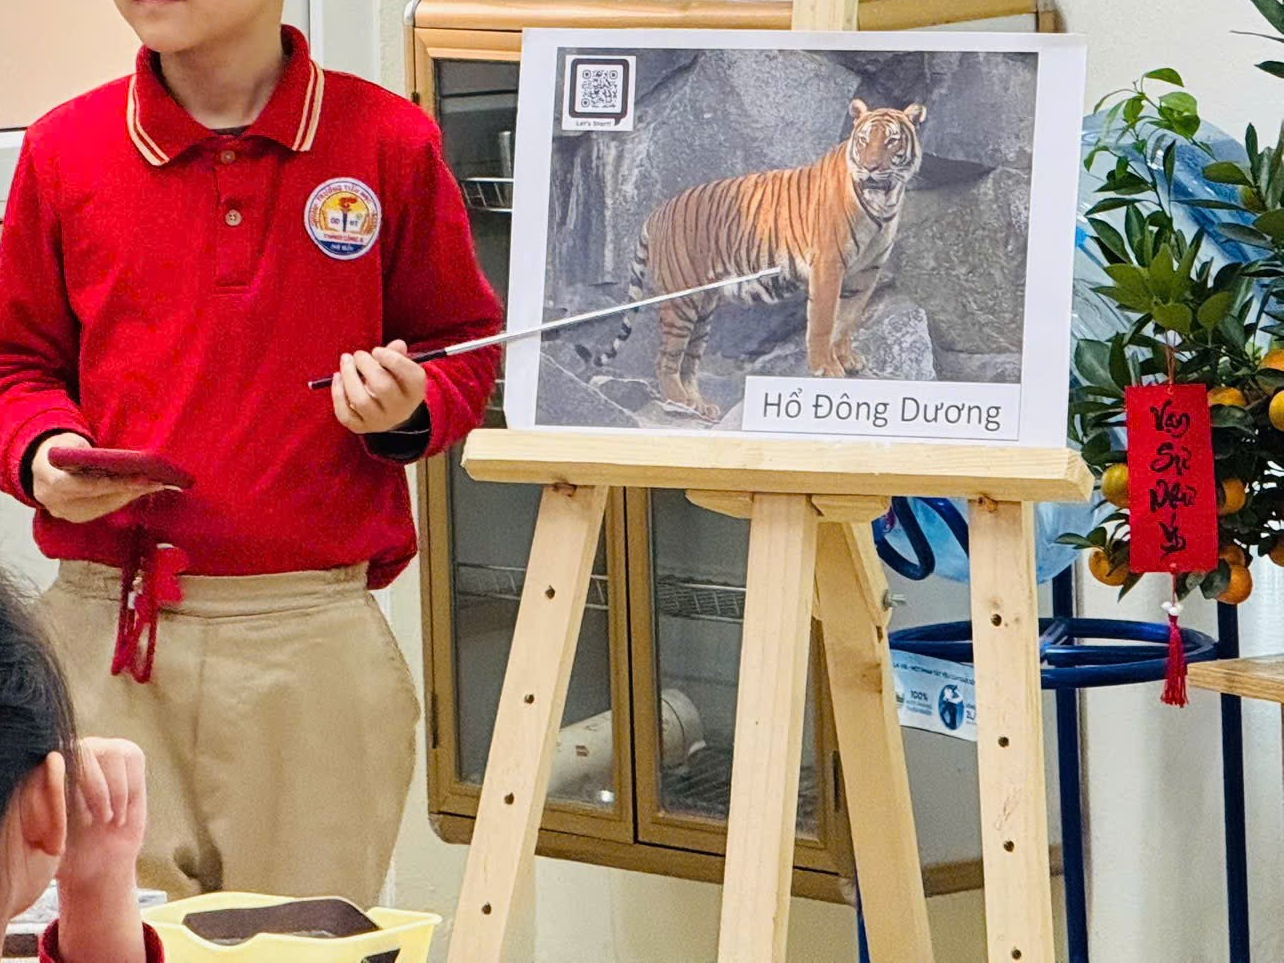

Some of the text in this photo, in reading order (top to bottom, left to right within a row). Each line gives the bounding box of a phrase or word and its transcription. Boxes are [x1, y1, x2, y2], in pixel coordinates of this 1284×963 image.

[763, 388, 1003, 432] Hổ Đông Dương
